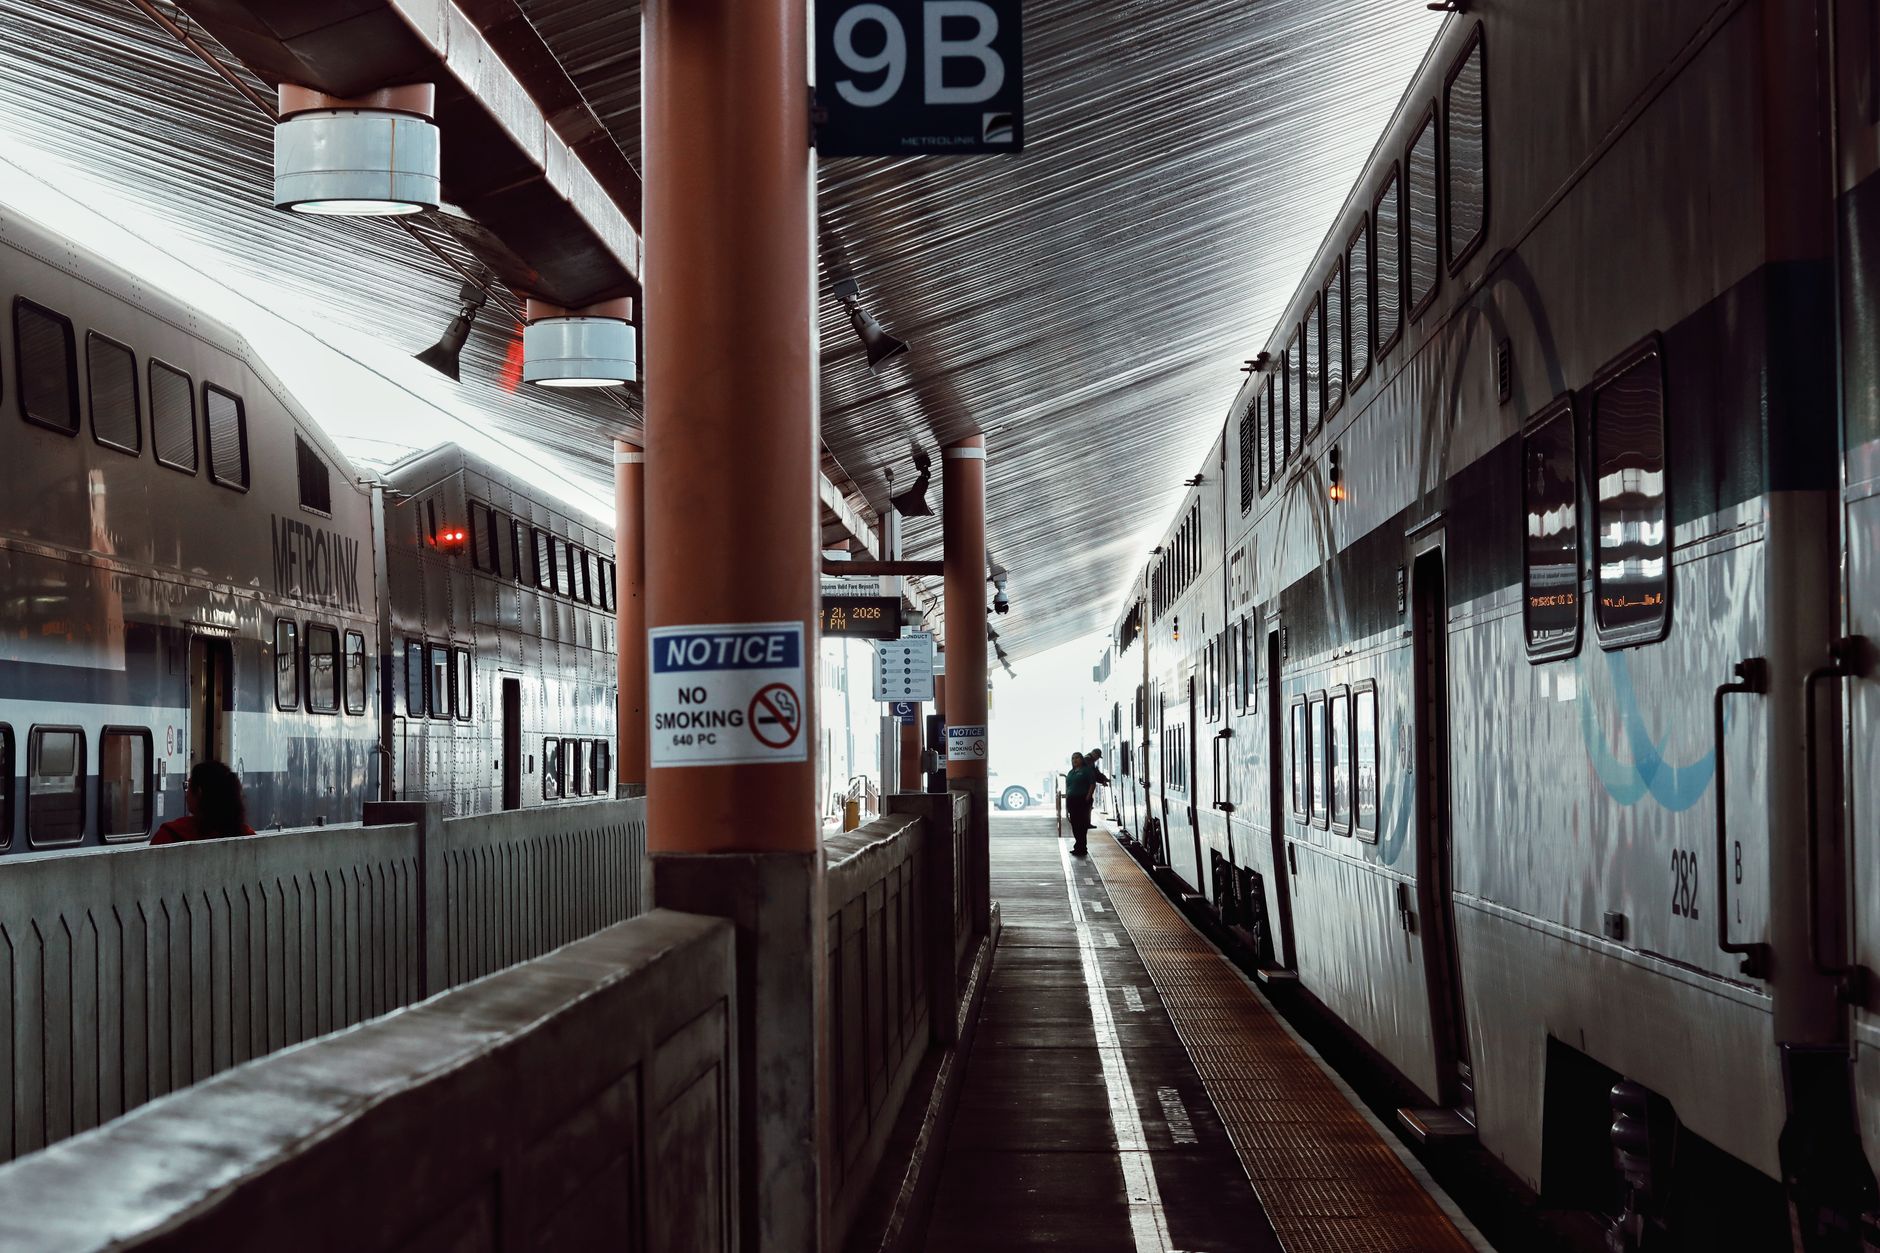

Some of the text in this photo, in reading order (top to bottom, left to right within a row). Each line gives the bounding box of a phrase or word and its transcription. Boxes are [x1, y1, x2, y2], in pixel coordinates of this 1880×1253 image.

[833, 2, 1005, 108] 9B
[901, 136, 976, 146] METROLINK
[271, 513, 361, 614] METROLINK
[859, 583, 873, 591] Beyond
[853, 607, 881, 619] 2026
[830, 618, 846, 630] PM
[667, 635, 785, 667] NOTICE
[678, 686, 707, 705] NO
[655, 709, 744, 730] SMOKING
[673, 733, 717, 746] 640 PC
[952, 728, 982, 736] NOTICE
[1734, 840, 1743, 885] B
[1671, 848, 1699, 920] 282
